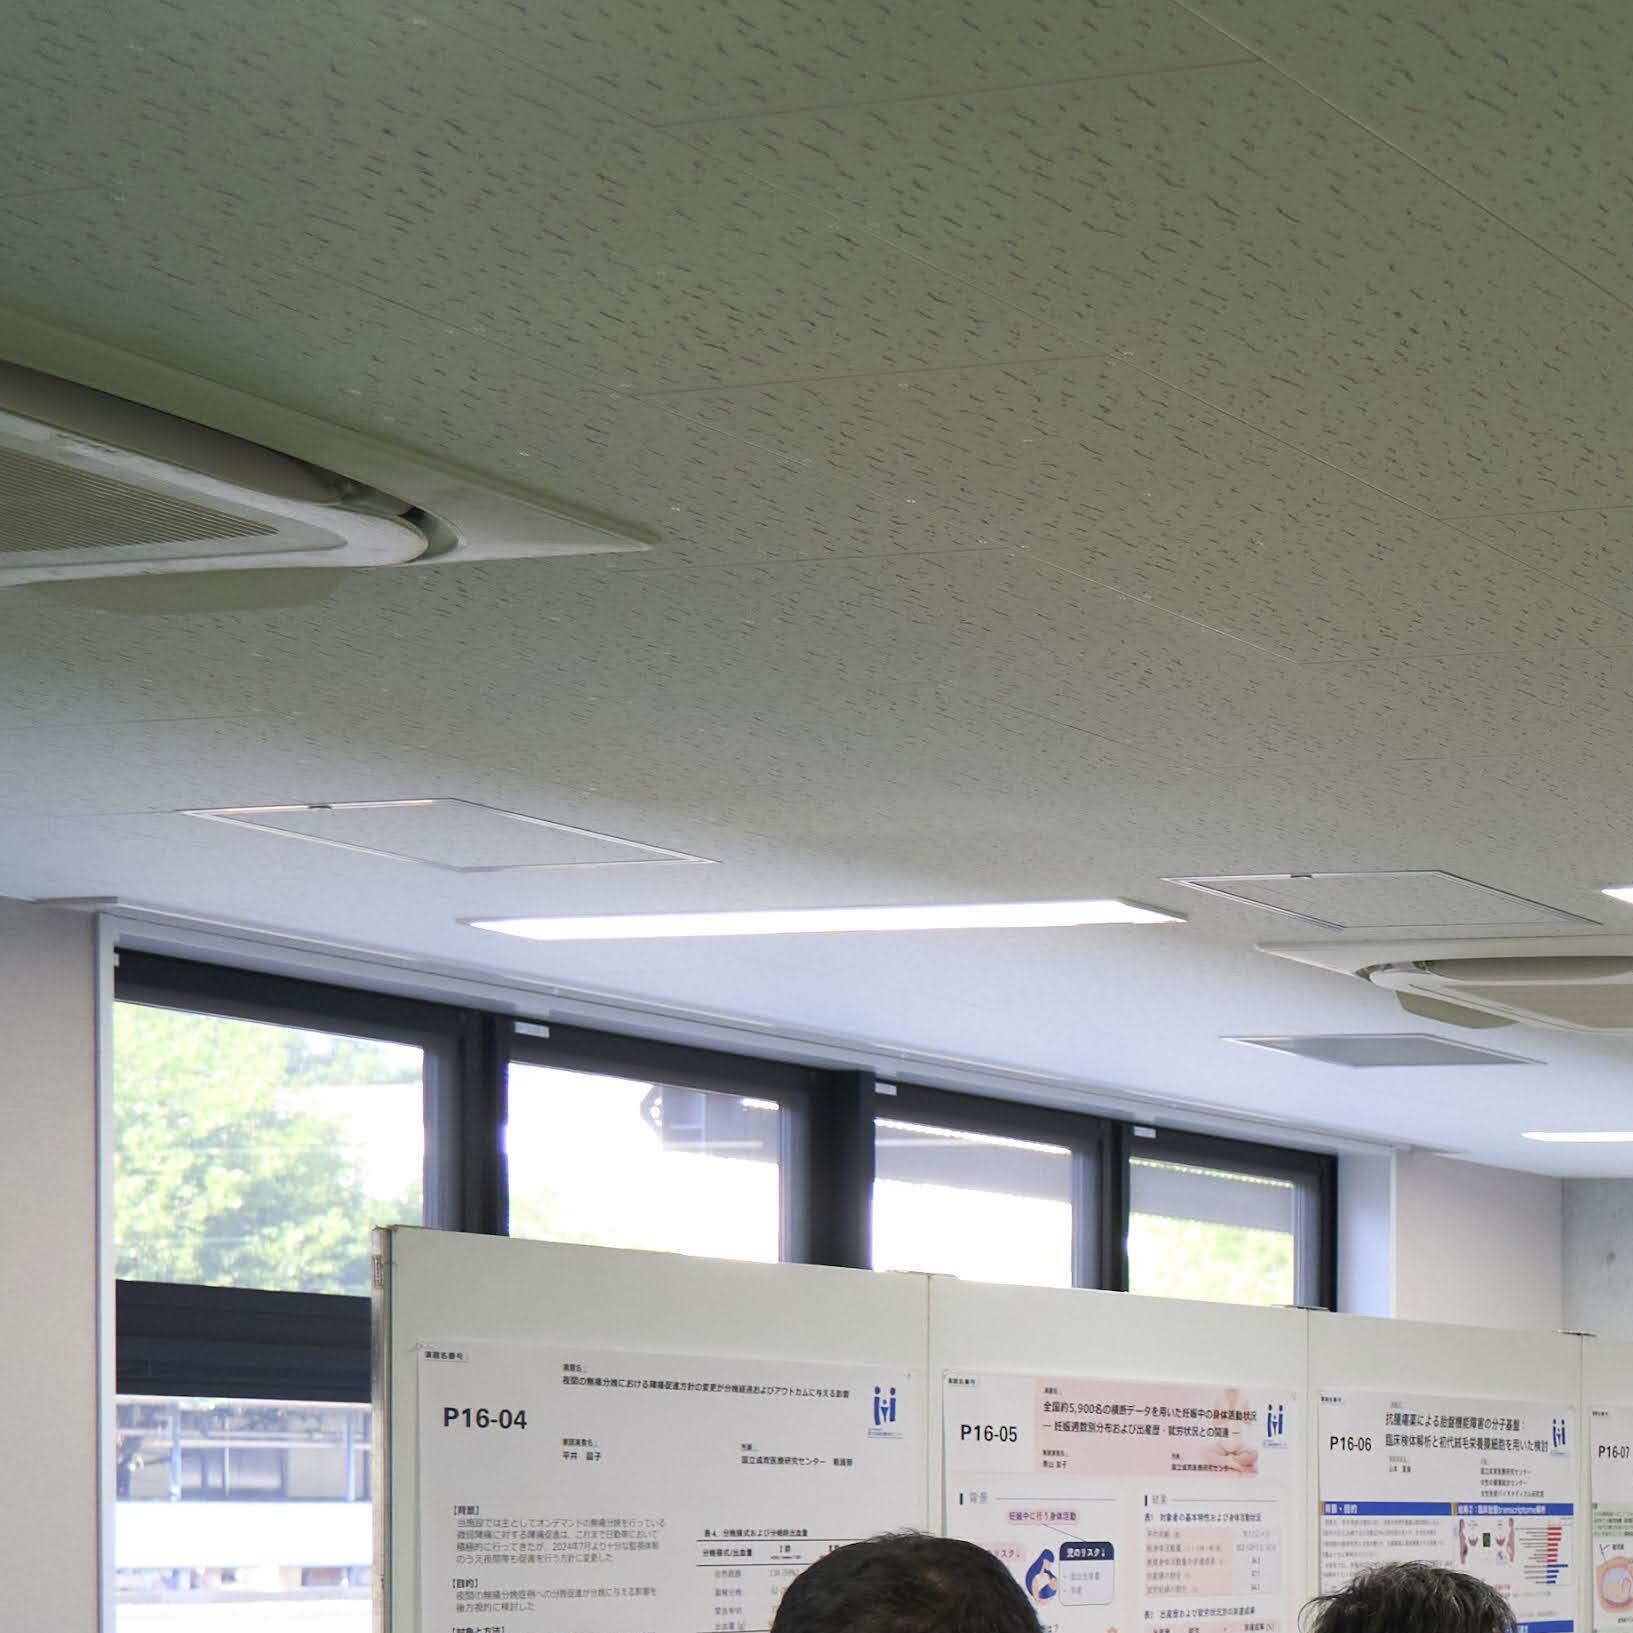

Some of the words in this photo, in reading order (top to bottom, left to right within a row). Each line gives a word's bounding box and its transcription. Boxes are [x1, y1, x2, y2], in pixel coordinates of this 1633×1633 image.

[443, 1407, 528, 1430] P16-04
[960, 1424, 1018, 1443] P16-05
[1329, 1436, 1372, 1452] P16-06
[1598, 1445, 1630, 1459] P16-07
